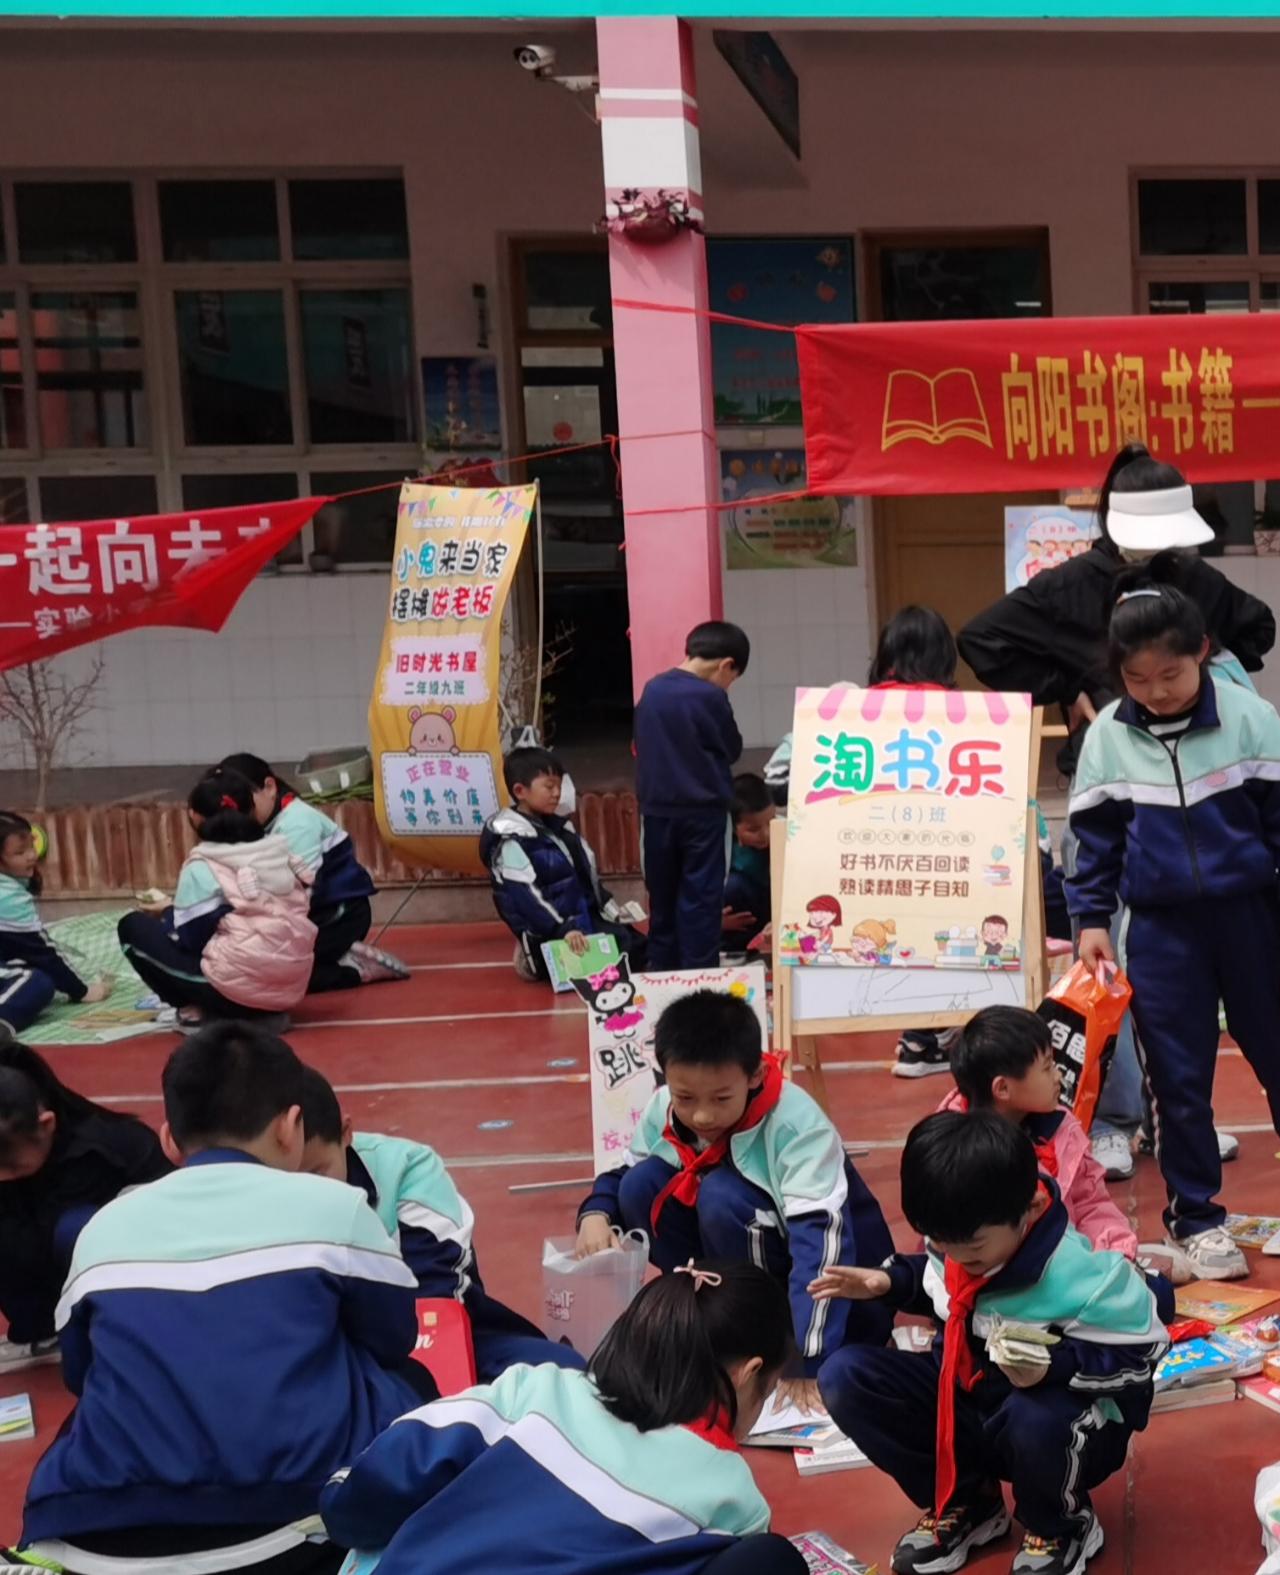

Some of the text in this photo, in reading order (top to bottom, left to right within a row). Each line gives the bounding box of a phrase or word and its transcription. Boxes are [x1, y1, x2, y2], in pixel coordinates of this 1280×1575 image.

[398, 539, 508, 581] 小鬼来当家
[396, 651, 477, 673] 旧时光书屋
[404, 680, 466, 696] 二年级九班
[406, 759, 471, 784] 正在营业
[812, 728, 1005, 796] 淘书乐
[839, 853, 971, 874] 好书不厌百回读
[838, 877, 970, 898] 熟读精思子自知
